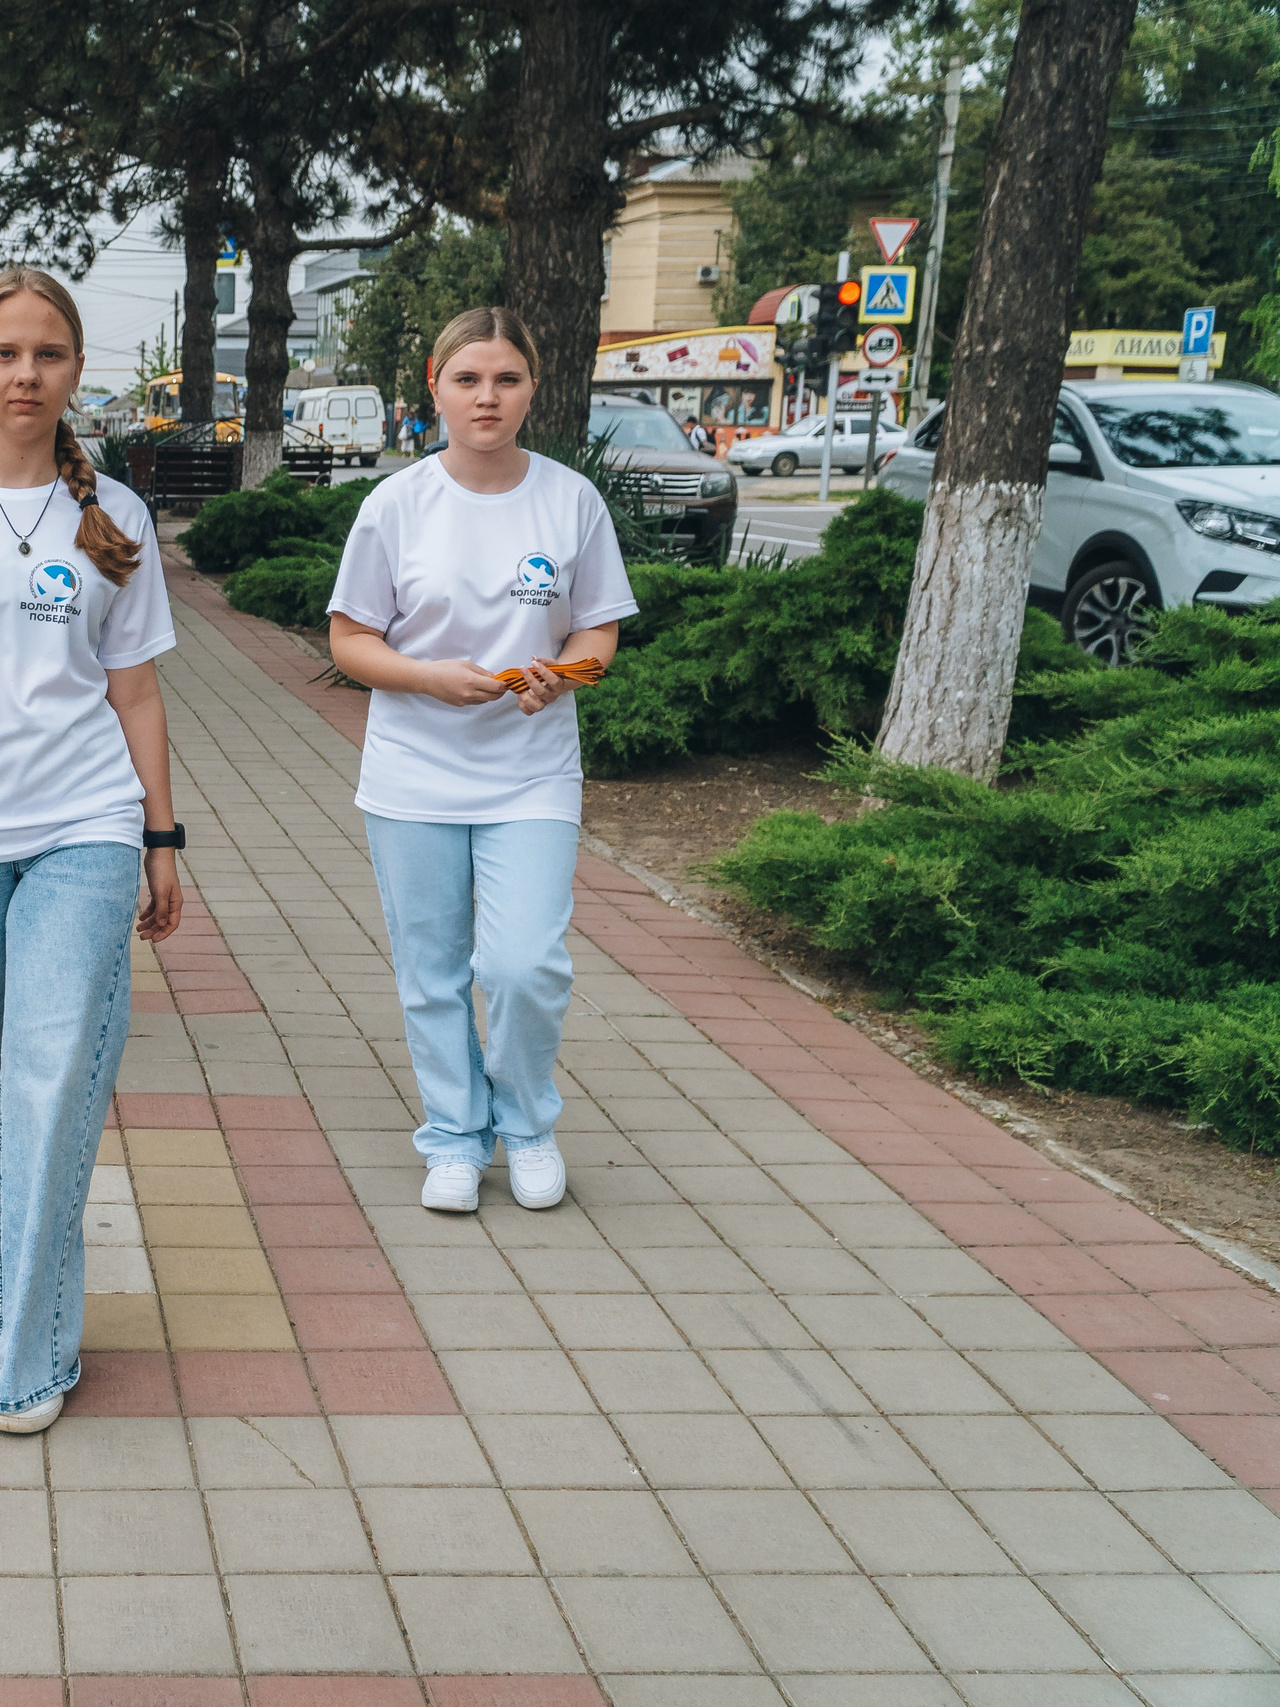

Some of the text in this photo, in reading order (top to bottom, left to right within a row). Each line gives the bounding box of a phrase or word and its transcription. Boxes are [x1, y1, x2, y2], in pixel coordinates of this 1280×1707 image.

[1188, 313, 1208, 351] P
[1069, 337, 1095, 357] АС
[20, 601, 82, 616] ВОЛОНТЁРЫ
